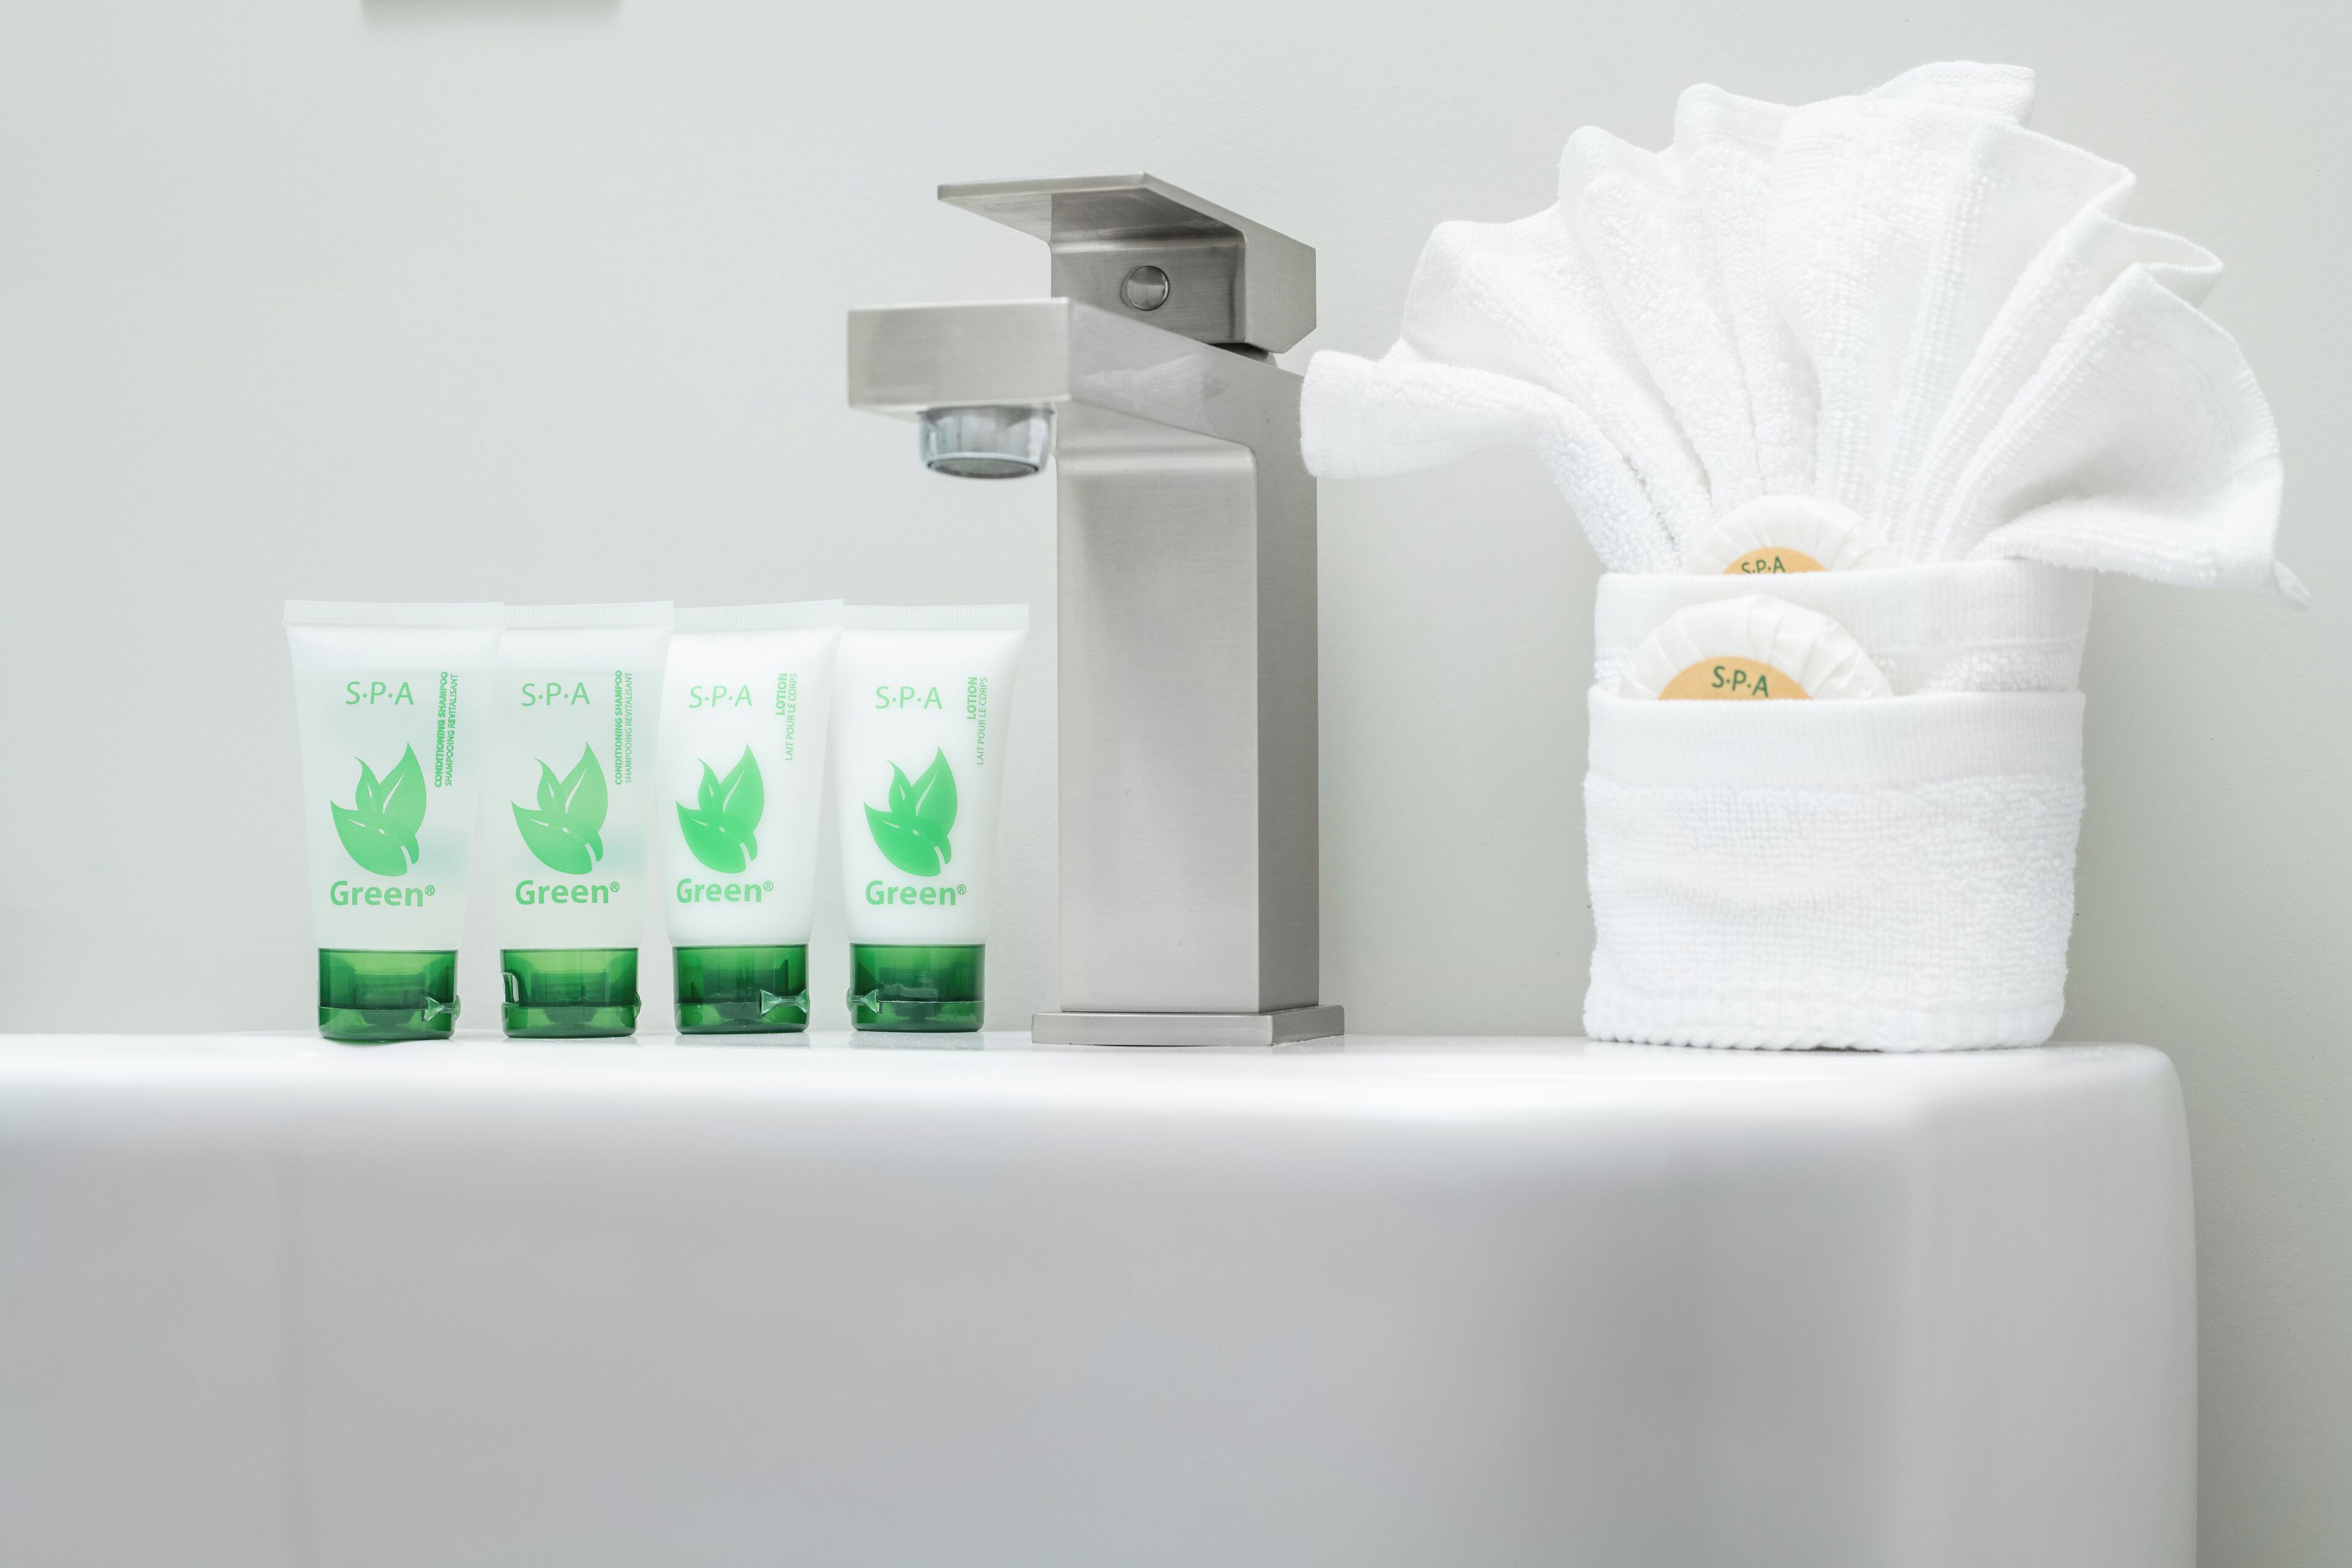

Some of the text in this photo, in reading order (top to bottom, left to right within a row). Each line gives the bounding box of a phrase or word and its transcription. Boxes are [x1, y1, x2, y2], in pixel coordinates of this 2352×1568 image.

[775, 673, 788, 715] LOTION
[785, 673, 797, 761] LAIT POUR LE CORPS
[967, 677, 978, 720] LOTION
[978, 707, 986, 717] LE
[979, 677, 987, 706] CORPS
[434, 671, 448, 788] CONDITIONING SHAMPOO
[445, 674, 458, 787] SHAMPOOING REVITALISANT
[614, 670, 623, 785] CONDITIONING SHAMPOO
